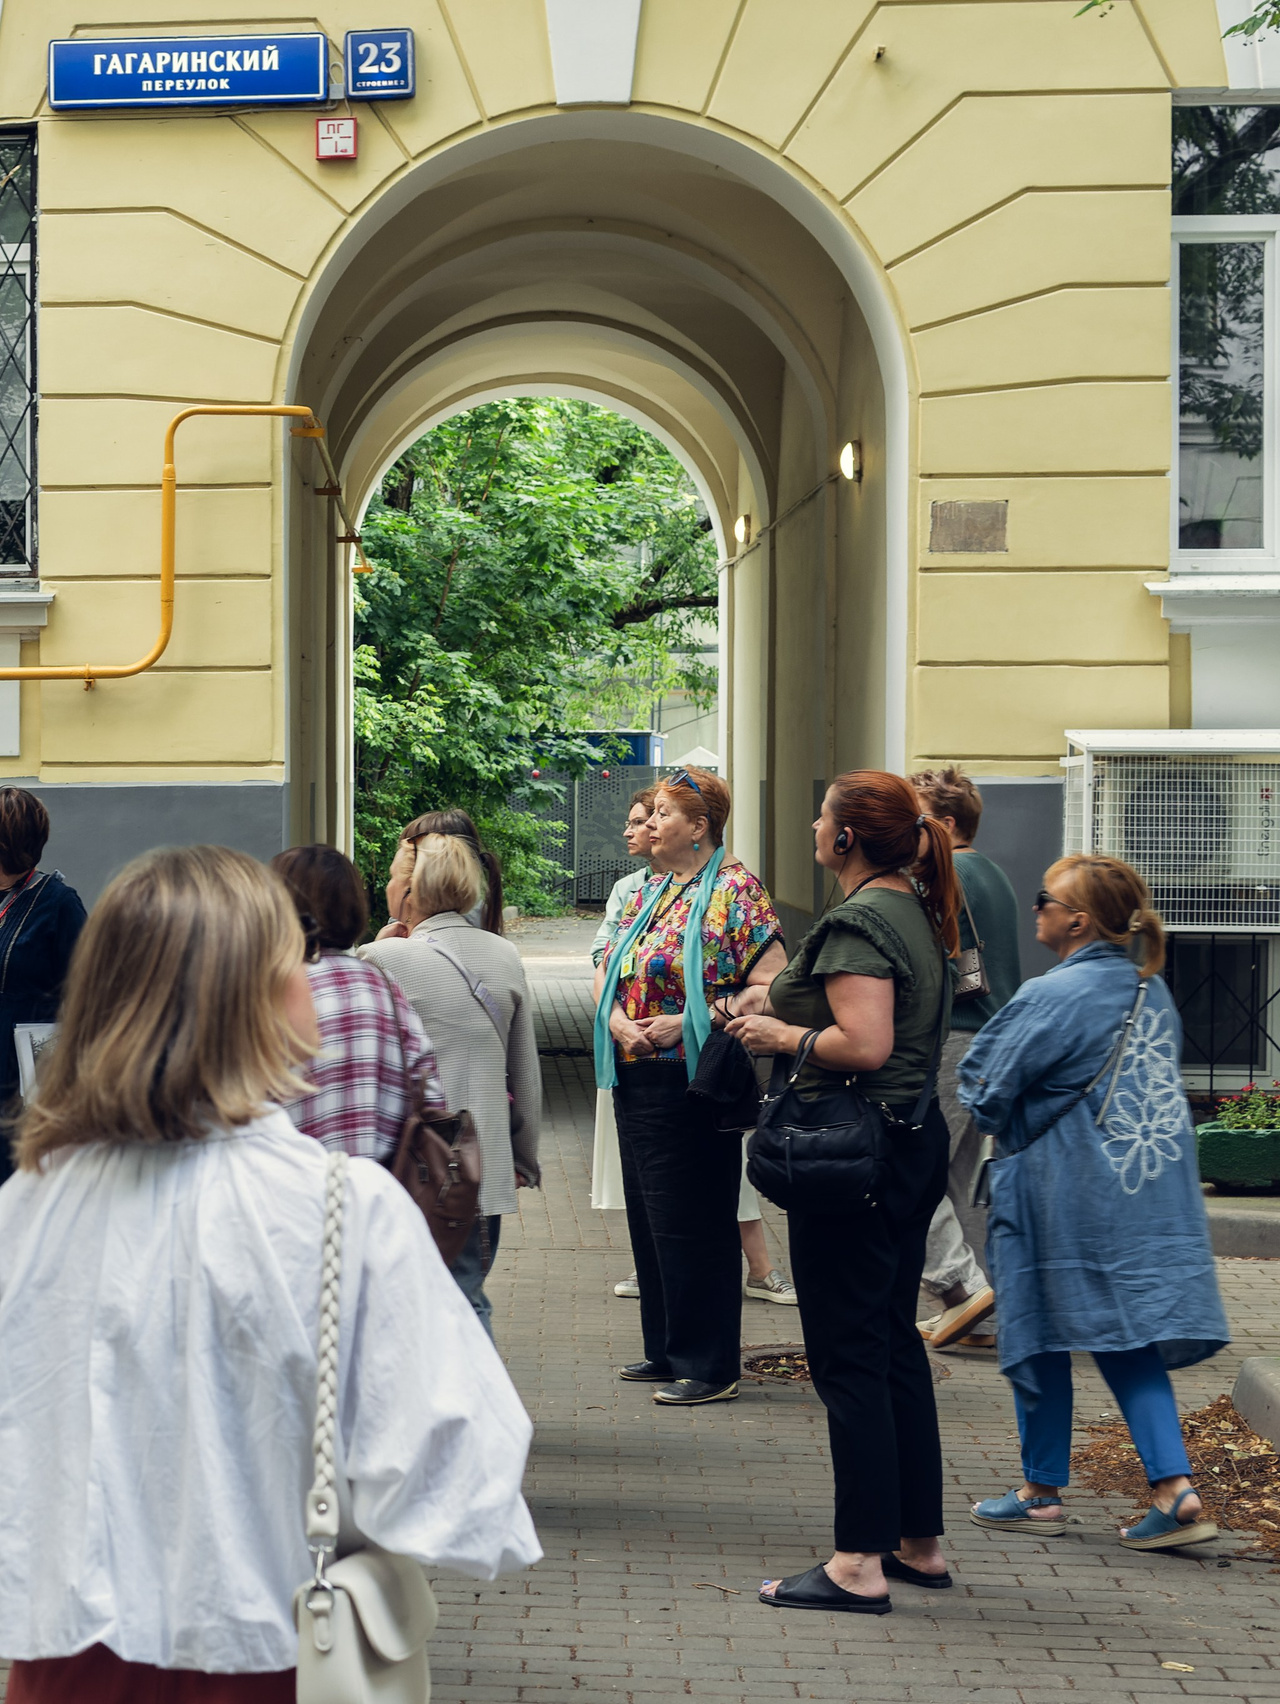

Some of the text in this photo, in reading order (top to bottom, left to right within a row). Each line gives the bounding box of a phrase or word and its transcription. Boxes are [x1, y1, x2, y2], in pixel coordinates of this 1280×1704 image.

[93, 45, 280, 75] ГАГАРИНСКИЙ
[358, 42, 401, 73] 23
[142, 78, 230, 91] ПЕРЕУЛОК
[327, 123, 344, 134] ПГ
